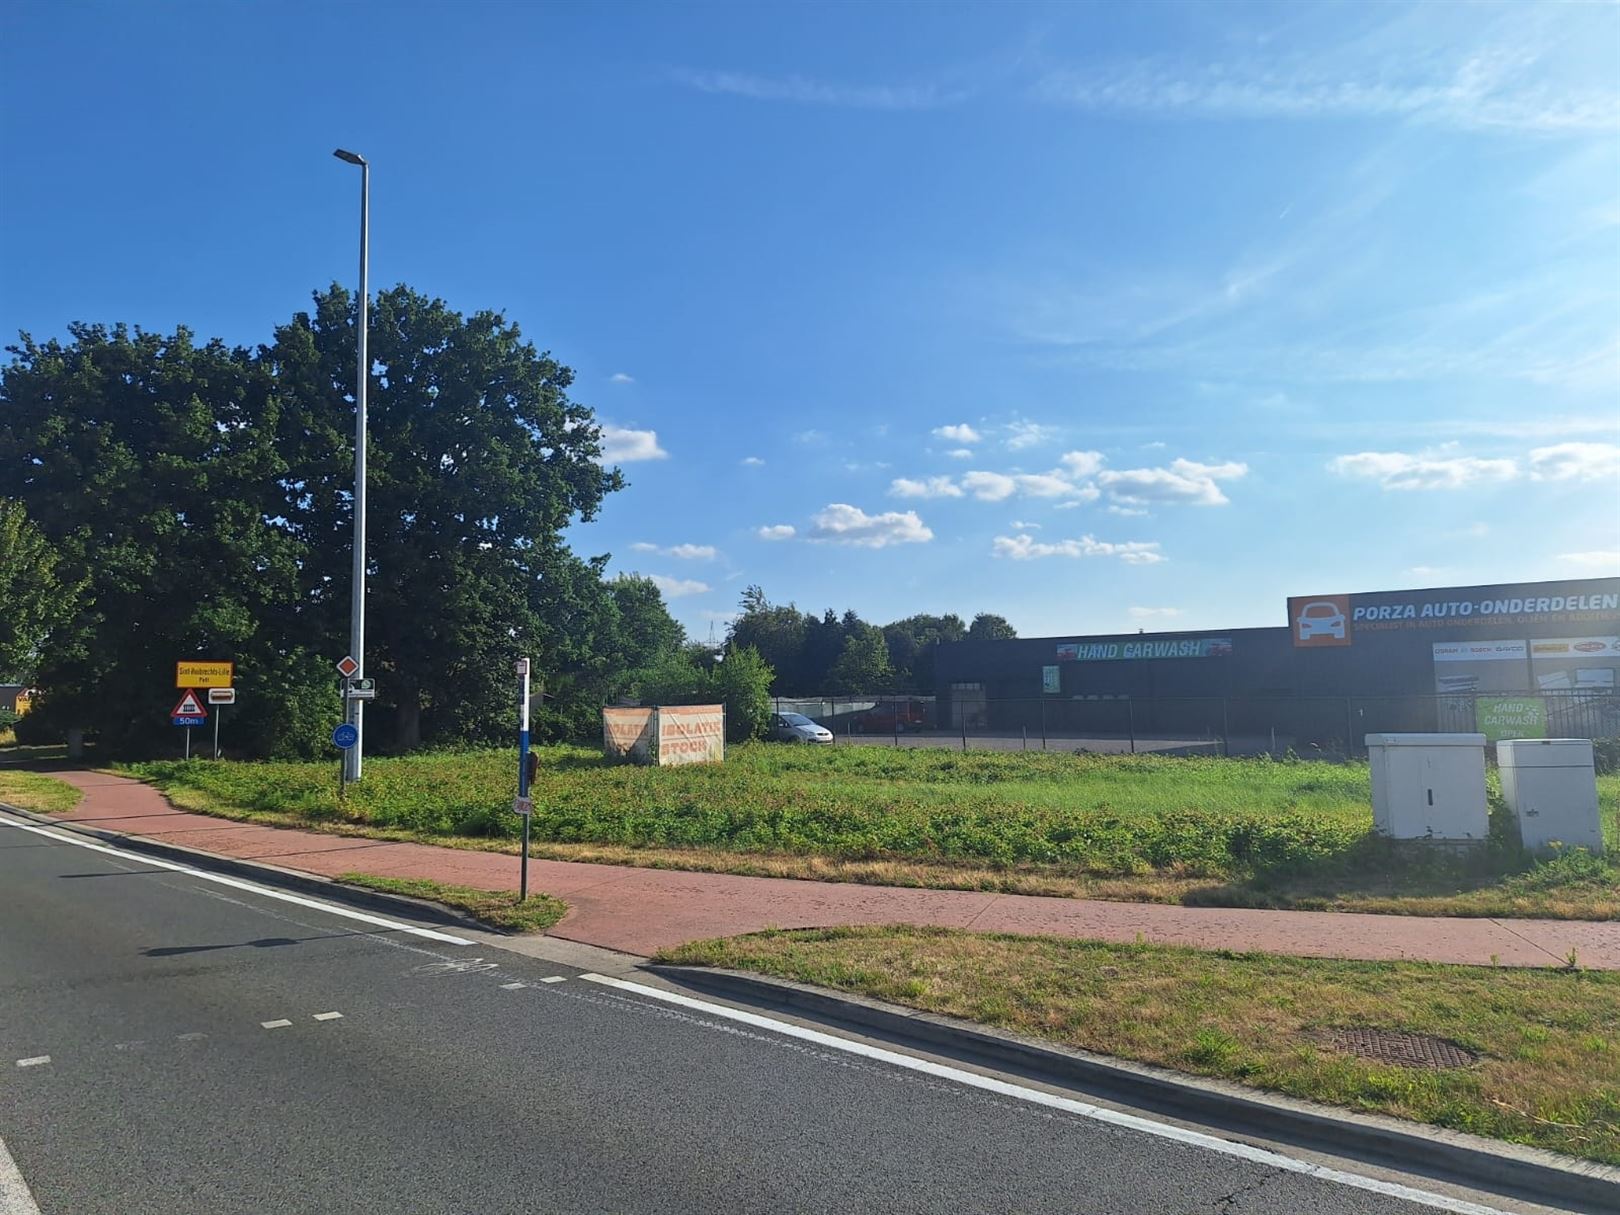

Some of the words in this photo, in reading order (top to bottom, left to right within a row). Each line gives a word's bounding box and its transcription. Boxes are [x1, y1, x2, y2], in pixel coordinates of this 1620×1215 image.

[1353, 604, 1416, 620] PORZA
[1420, 594, 1618, 618] AUTO-ONDERDELEN
[1077, 643, 1118, 659] HAND
[1123, 640, 1202, 658] CARWASH
[1493, 703, 1524, 713] HAND
[179, 717, 199, 725] 50m
[1485, 715, 1538, 726] CARWASH
